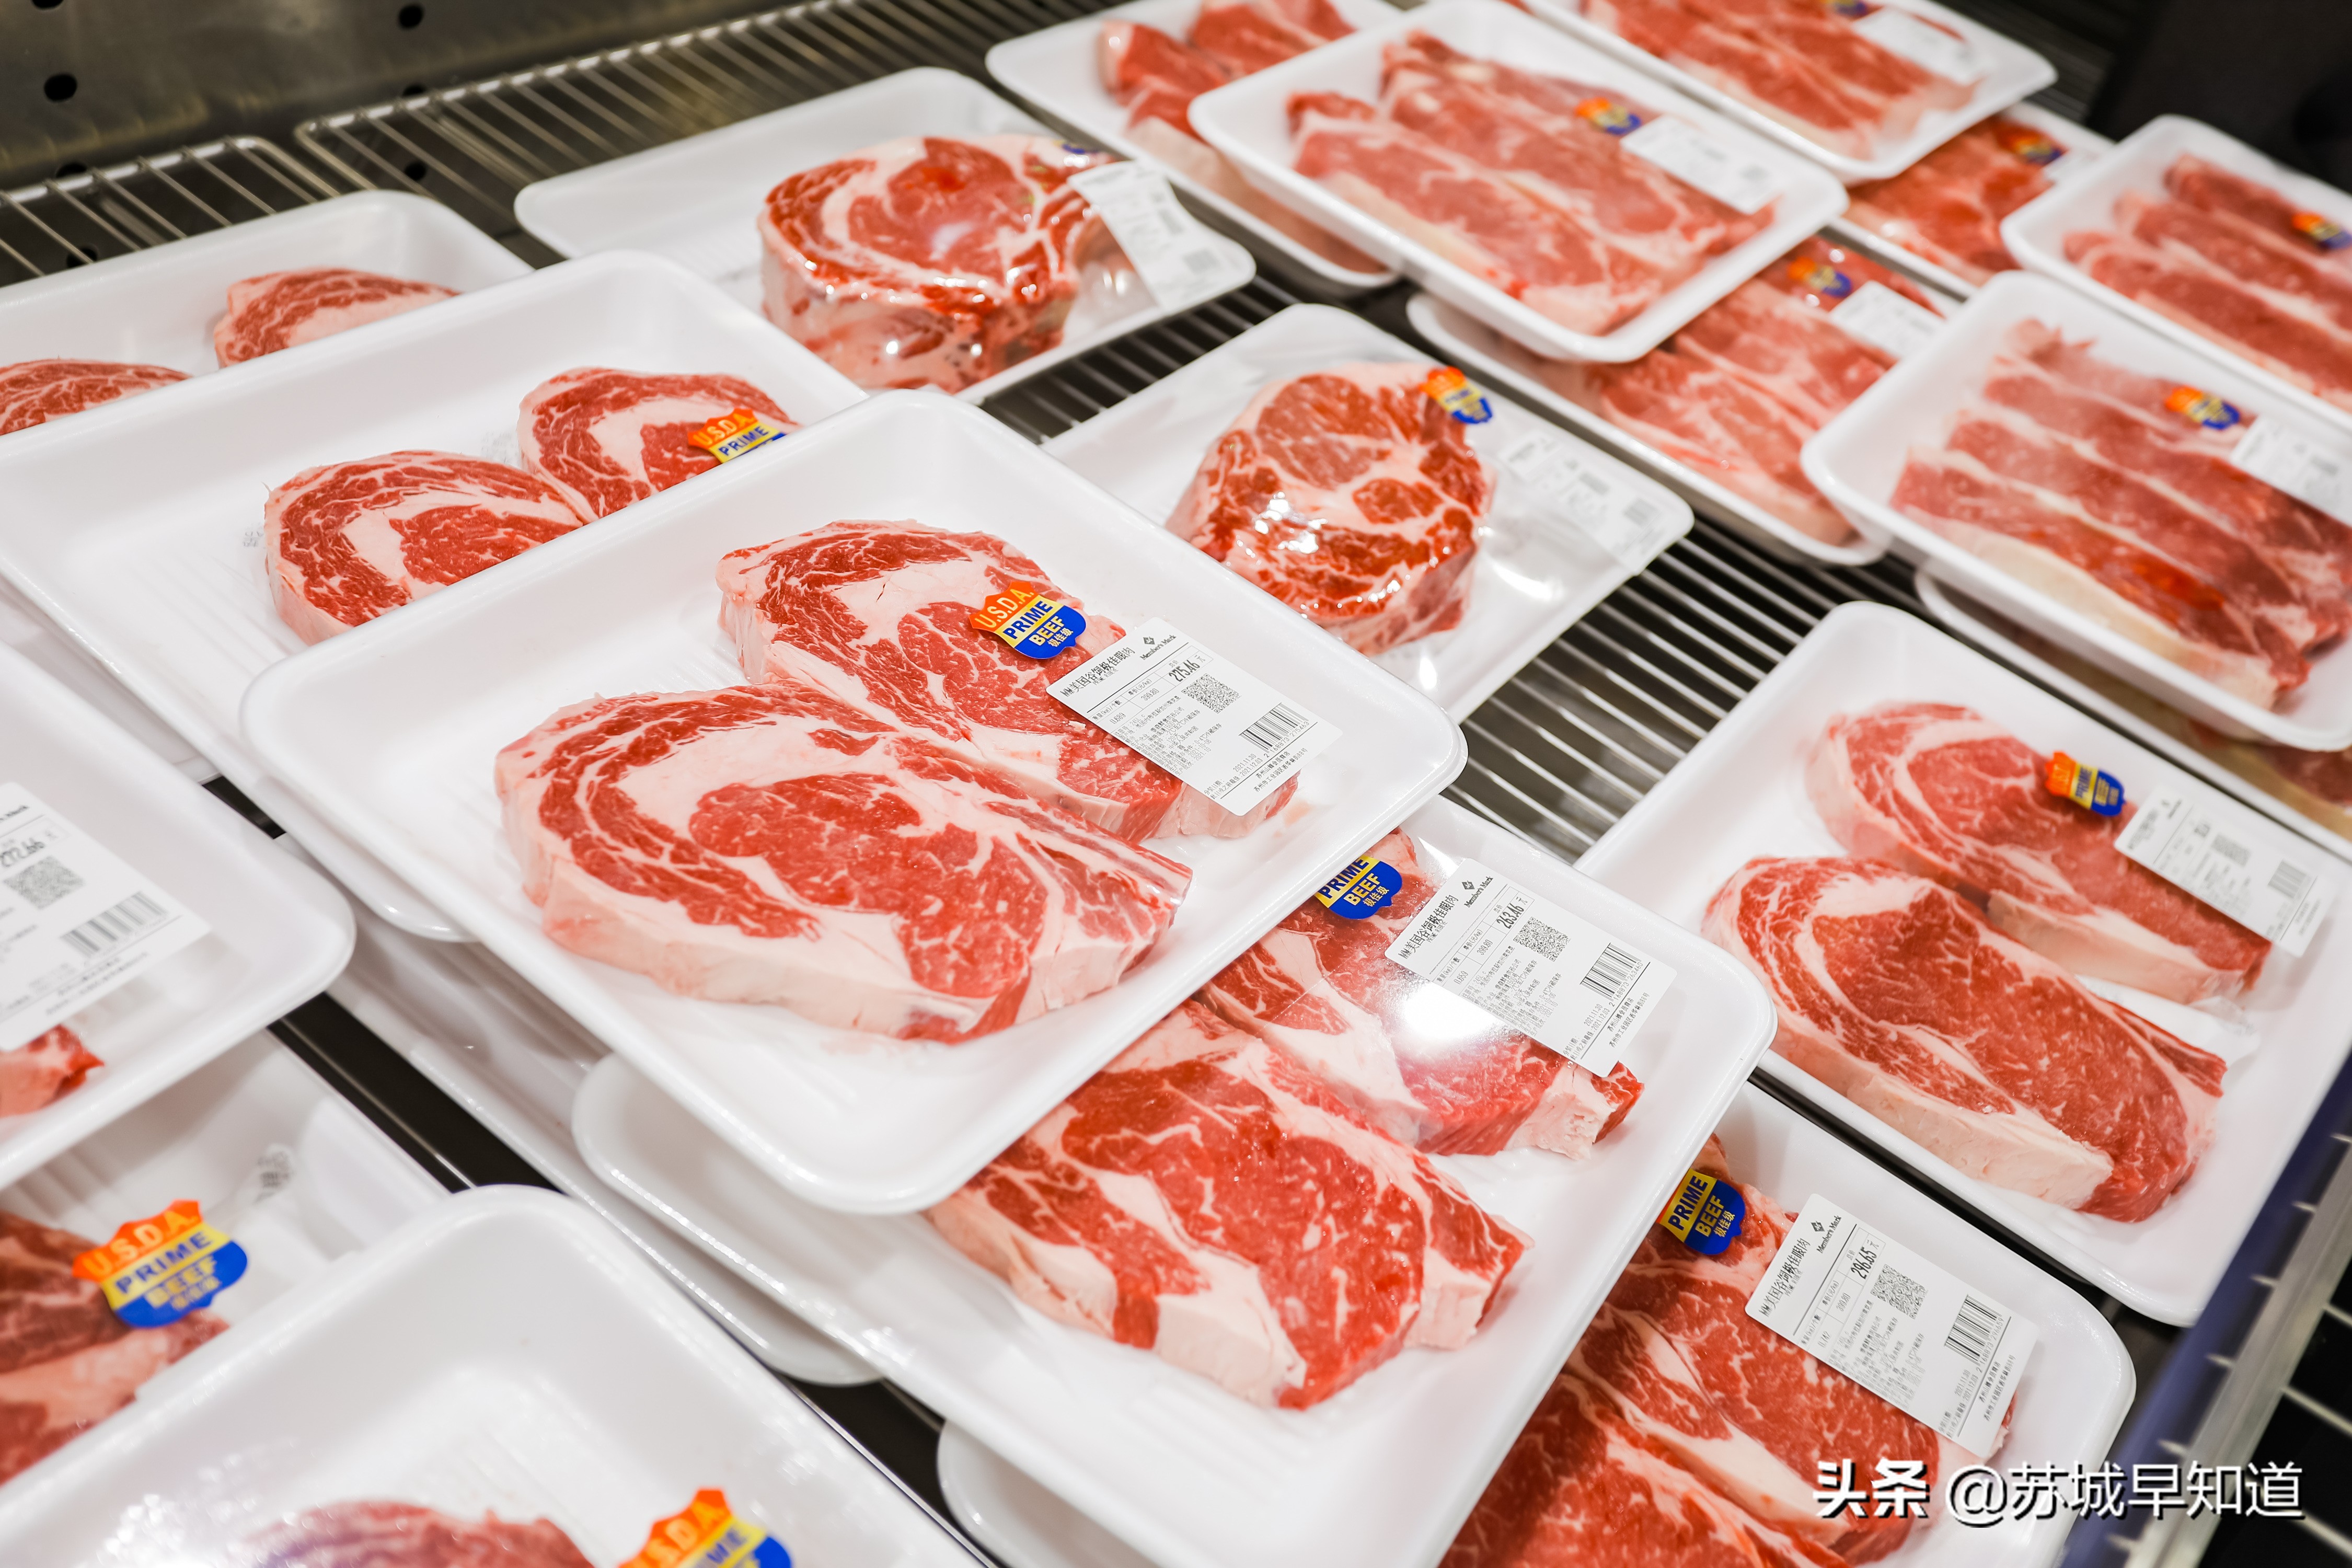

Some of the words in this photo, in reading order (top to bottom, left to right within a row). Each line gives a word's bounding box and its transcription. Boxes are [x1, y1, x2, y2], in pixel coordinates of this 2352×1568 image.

[718, 425, 769, 456] PRIME
[974, 588, 1034, 628] U.S.D.A.
[1002, 600, 1054, 640] PRIME
[1028, 615, 1065, 646] BEEF
[1047, 627, 1074, 648] 极佳级
[1139, 643, 1164, 660] Member's
[1160, 635, 1177, 644] Mark
[1059, 647, 1135, 697] MM美国谷饲极佳眼肉
[1167, 659, 1200, 682] 275.46
[1140, 688, 1159, 700] 399.80
[1109, 712, 1126, 724] 0.689
[1268, 737, 1289, 753] 168873
[1289, 721, 1309, 736] 275463
[1318, 859, 1369, 899] PRIME
[1343, 872, 1380, 906] BEEF
[1463, 887, 1484, 908] Member's
[1479, 876, 1493, 889] Mark
[1362, 885, 1390, 907] 极佳级
[1398, 894, 1458, 959] MM美国谷饲极佳眼肉
[1494, 901, 1524, 929] 263.46
[1477, 939, 1493, 955] 399.80
[1454, 971, 1468, 984] 0.659
[1613, 982, 1629, 1000] 168873
[1627, 962, 1643, 981] 263460
[1668, 1175, 1709, 1231] PRIME
[1694, 1195, 1724, 1238] BEEF
[1713, 1210, 1736, 1238] 极佳级
[1816, 1229, 1834, 1253] Member's
[1828, 1214, 1841, 1230] Mark
[116, 1231, 213, 1295] PRIME
[1849, 1246, 1877, 1279] 296.65
